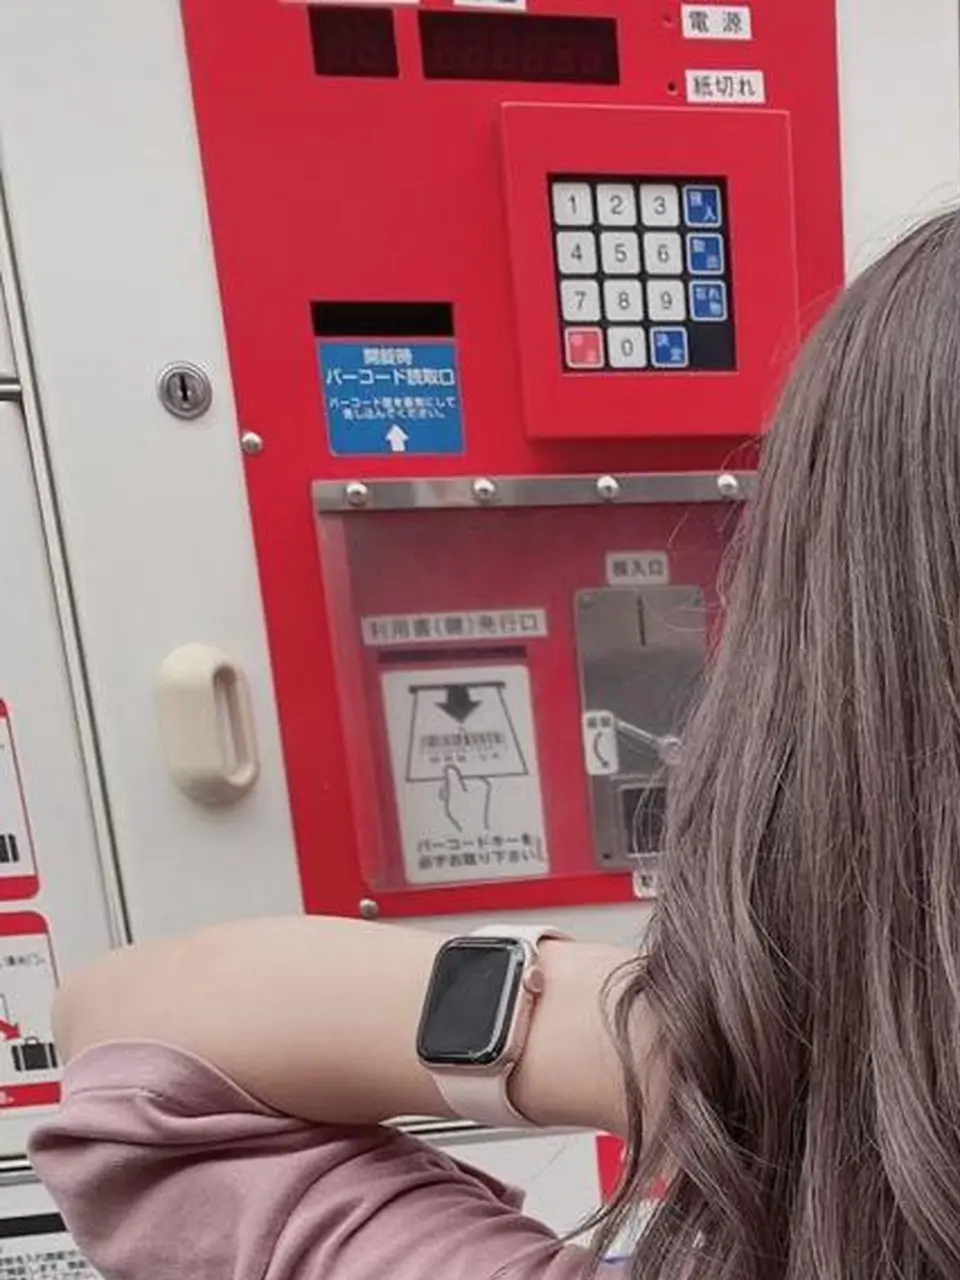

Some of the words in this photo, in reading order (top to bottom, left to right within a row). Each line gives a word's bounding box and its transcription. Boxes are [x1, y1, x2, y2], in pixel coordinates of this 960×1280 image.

[689, 11, 742, 33] 電源
[693, 75, 756, 98] 紙切れ
[569, 194, 577, 214] 1
[610, 195, 622, 215] 2
[654, 196, 666, 215] 3
[571, 244, 582, 262] 4
[615, 243, 627, 263] 5
[657, 244, 669, 263] 6
[575, 291, 587, 310] 7
[618, 291, 630, 310] 8
[660, 291, 672, 310] 9
[622, 339, 633, 357] 0
